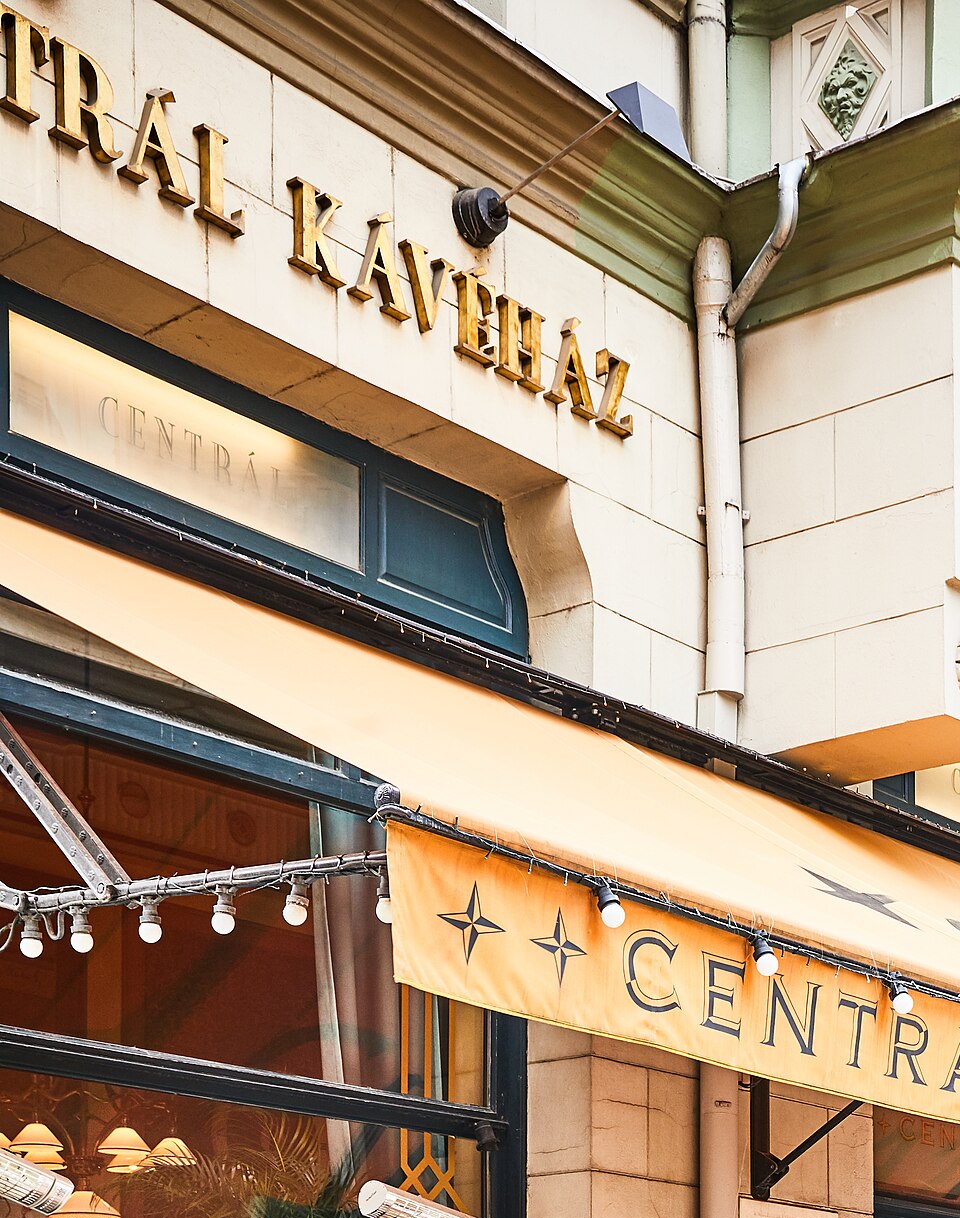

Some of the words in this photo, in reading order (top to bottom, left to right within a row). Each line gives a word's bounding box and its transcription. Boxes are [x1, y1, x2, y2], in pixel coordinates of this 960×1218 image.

[0, 1, 244, 239] TRÁL
[286, 176, 633, 440] KÁVÉHÁZ
[98, 396, 283, 504] CENTRÁL
